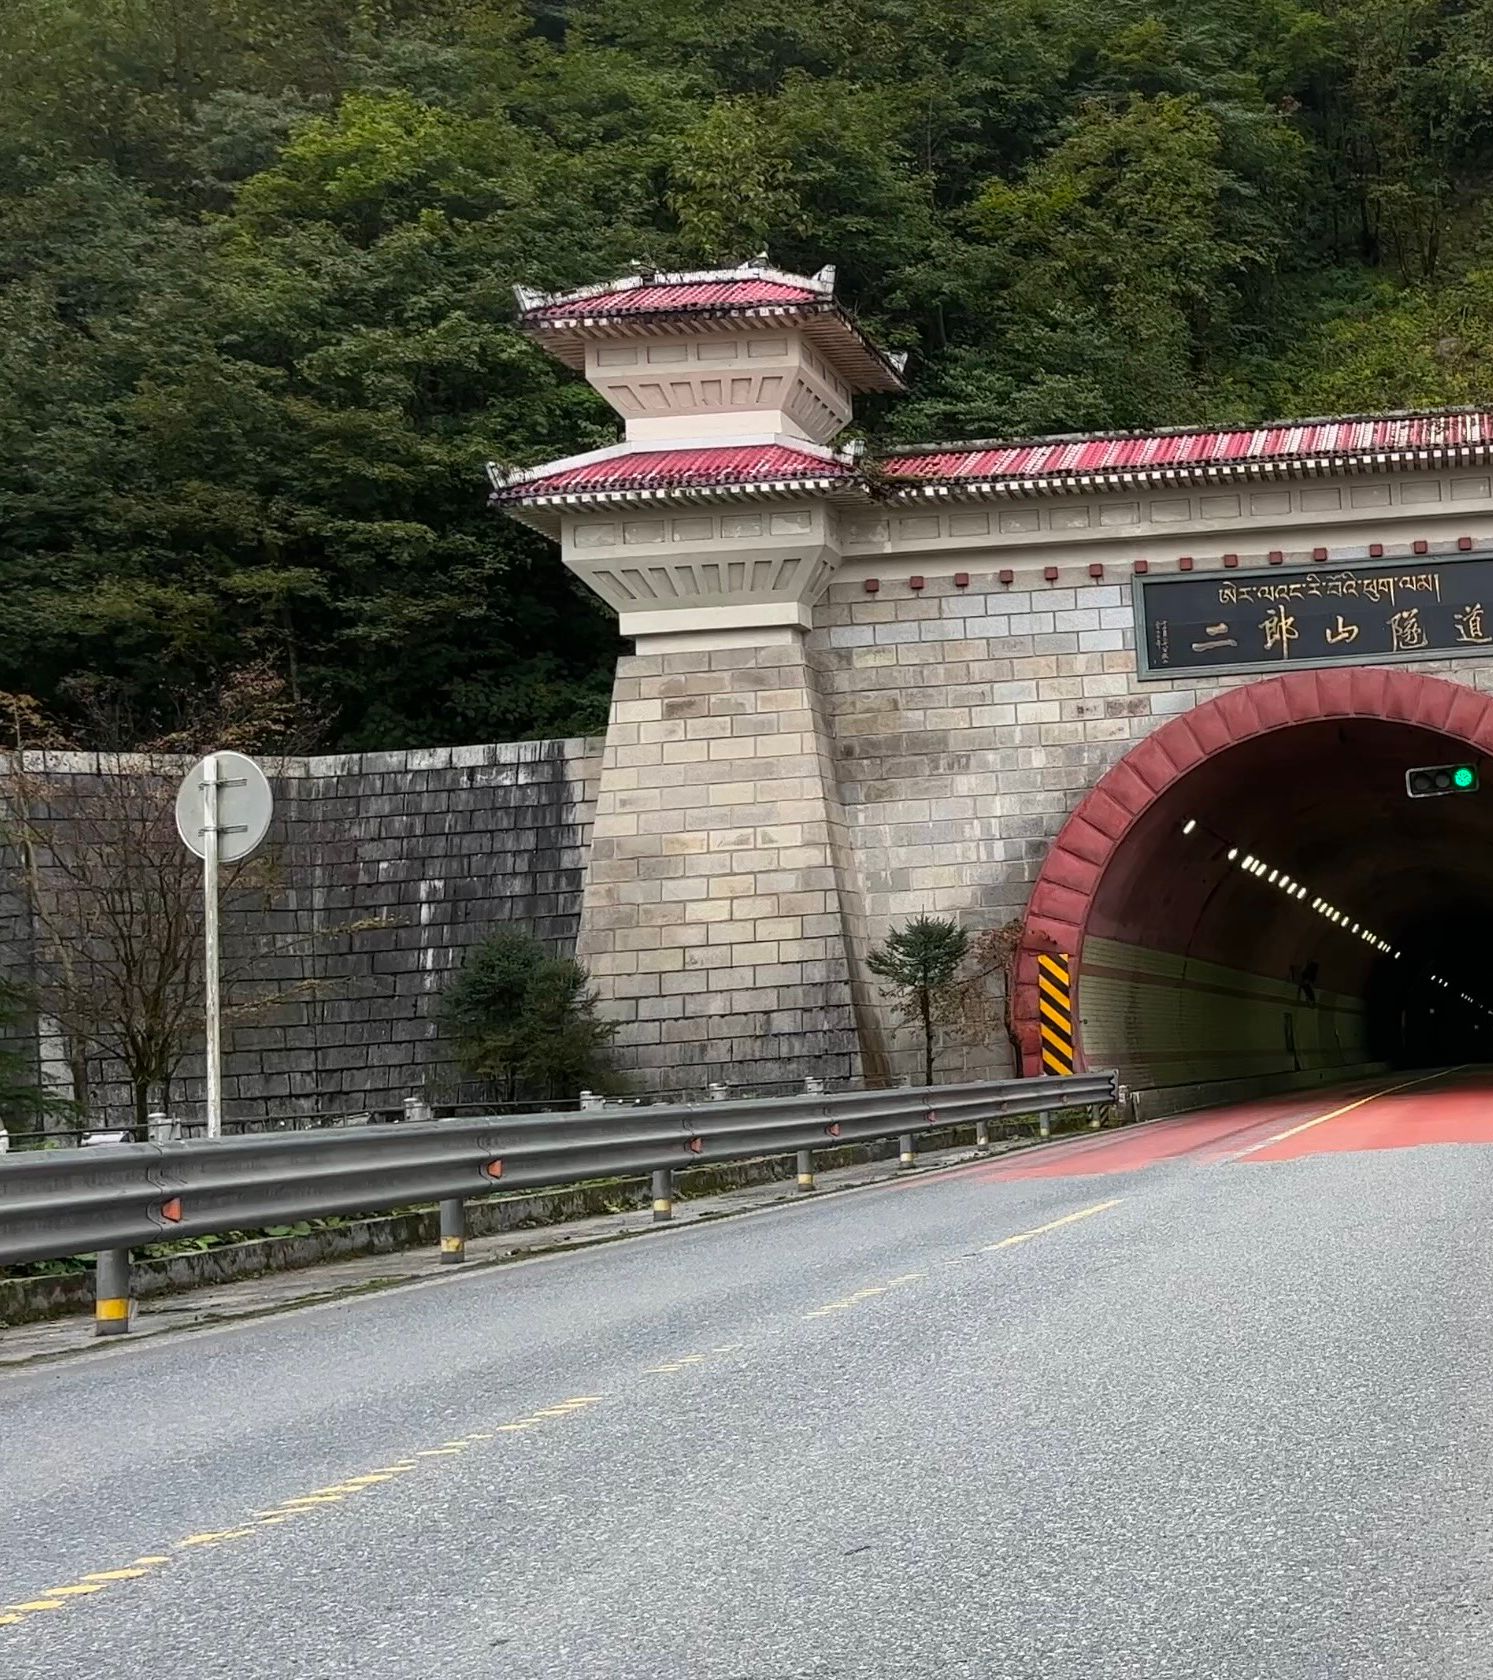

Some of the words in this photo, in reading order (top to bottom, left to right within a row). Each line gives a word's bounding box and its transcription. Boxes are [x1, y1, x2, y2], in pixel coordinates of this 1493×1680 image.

[1190, 602, 1493, 660] 二郎山隧道
